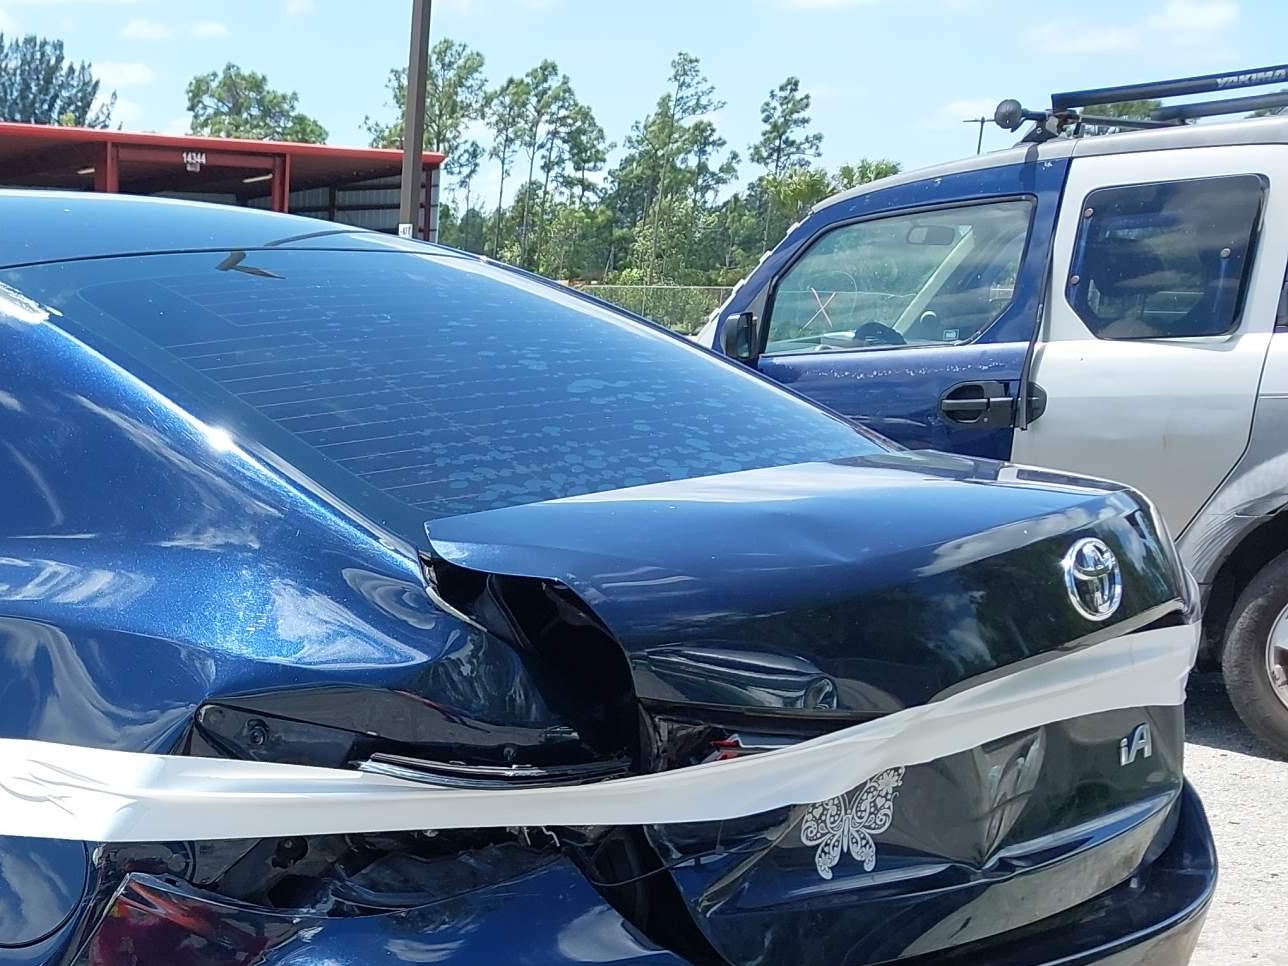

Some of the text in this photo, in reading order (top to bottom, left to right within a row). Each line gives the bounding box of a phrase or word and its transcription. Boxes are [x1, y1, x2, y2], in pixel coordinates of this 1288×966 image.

[1216, 69, 1287, 88] YAKIMA
[182, 151, 207, 165] 14344
[1120, 723, 1152, 766] iA
